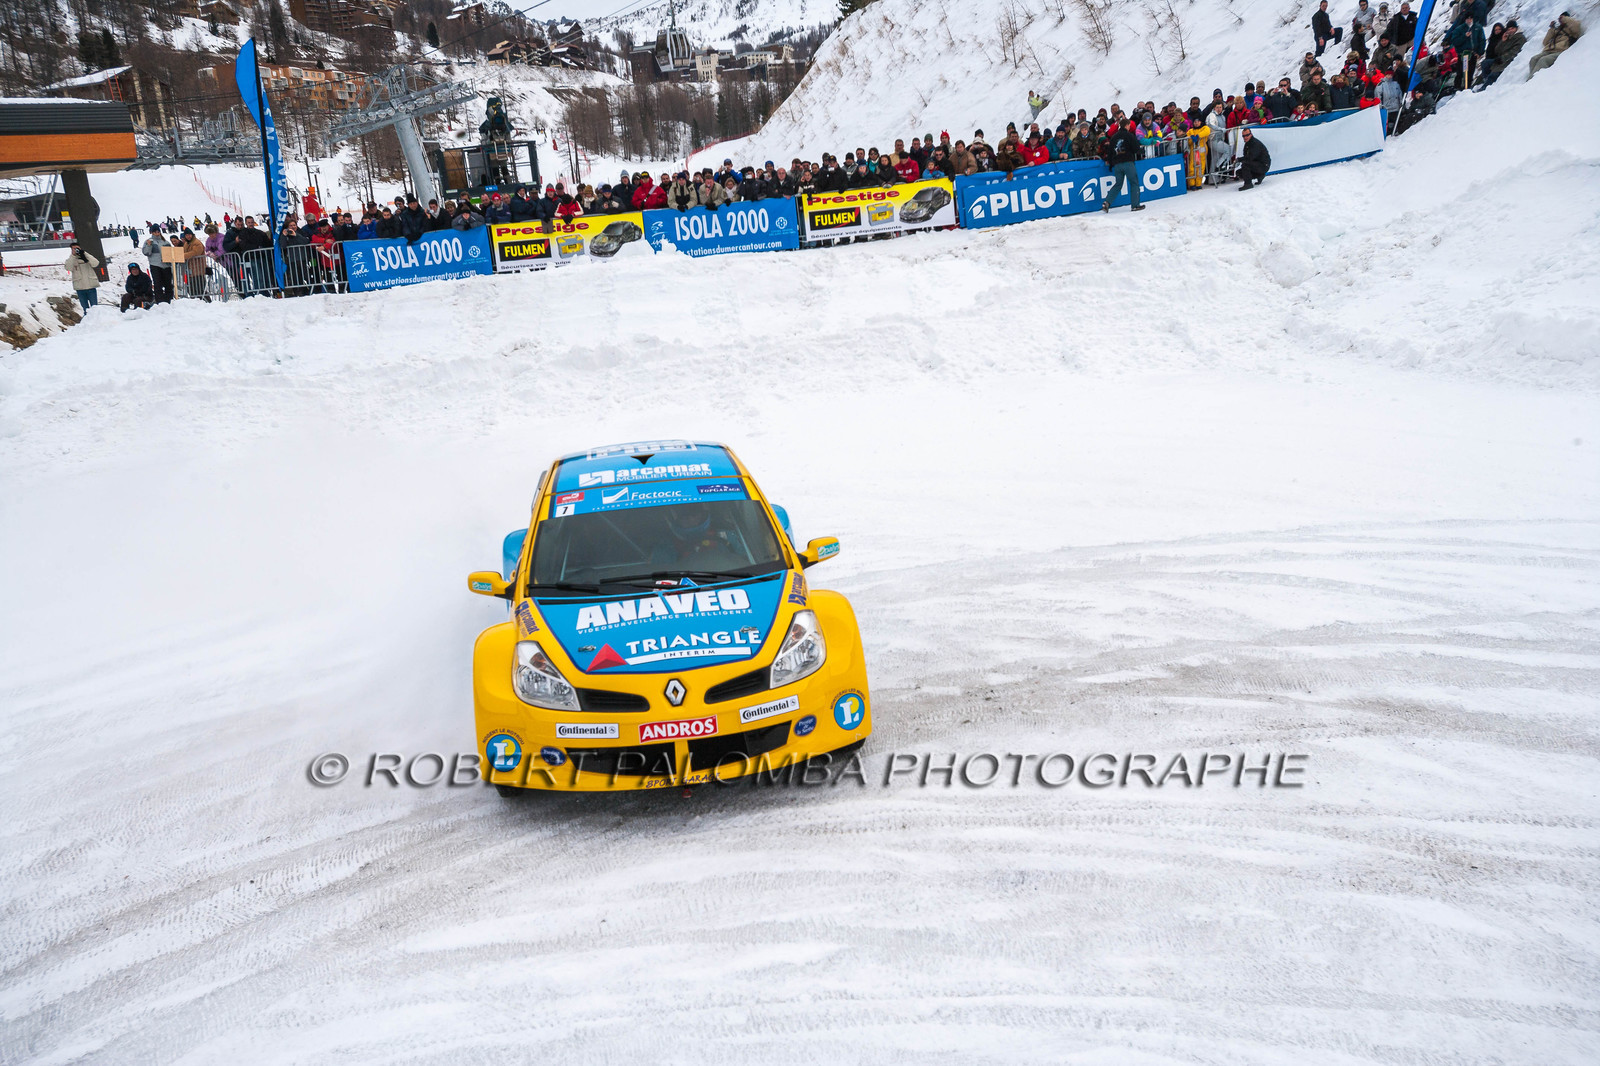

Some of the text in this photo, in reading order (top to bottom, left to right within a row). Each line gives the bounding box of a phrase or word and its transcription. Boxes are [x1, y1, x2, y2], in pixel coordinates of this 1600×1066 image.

[1100, 164, 1182, 199] PIOT
[807, 189, 900, 205] Prestige
[989, 182, 1074, 216] PILOT
[674, 208, 769, 241] ISOLA 2000
[815, 212, 856, 226] FULMEN
[496, 222, 589, 236] Presige
[372, 237, 462, 271] ISOLA 2000
[504, 243, 545, 257] FULMEN
[684, 241, 782, 256] stationsdumercantour.com
[616, 463, 711, 478] arcomat
[616, 470, 712, 482] MOBILIER URBAIN
[562, 506, 569, 515] 7
[576, 588, 750, 630] ANAVEO
[577, 609, 753, 635] VIDEOSURVEILLANCE INTELLIGENTE
[626, 629, 761, 655] TRIANGLE
[664, 650, 716, 658] INTERIM
[742, 700, 790, 720] Continental
[558, 725, 608, 736] Continental
[641, 718, 715, 740] ANDROS
